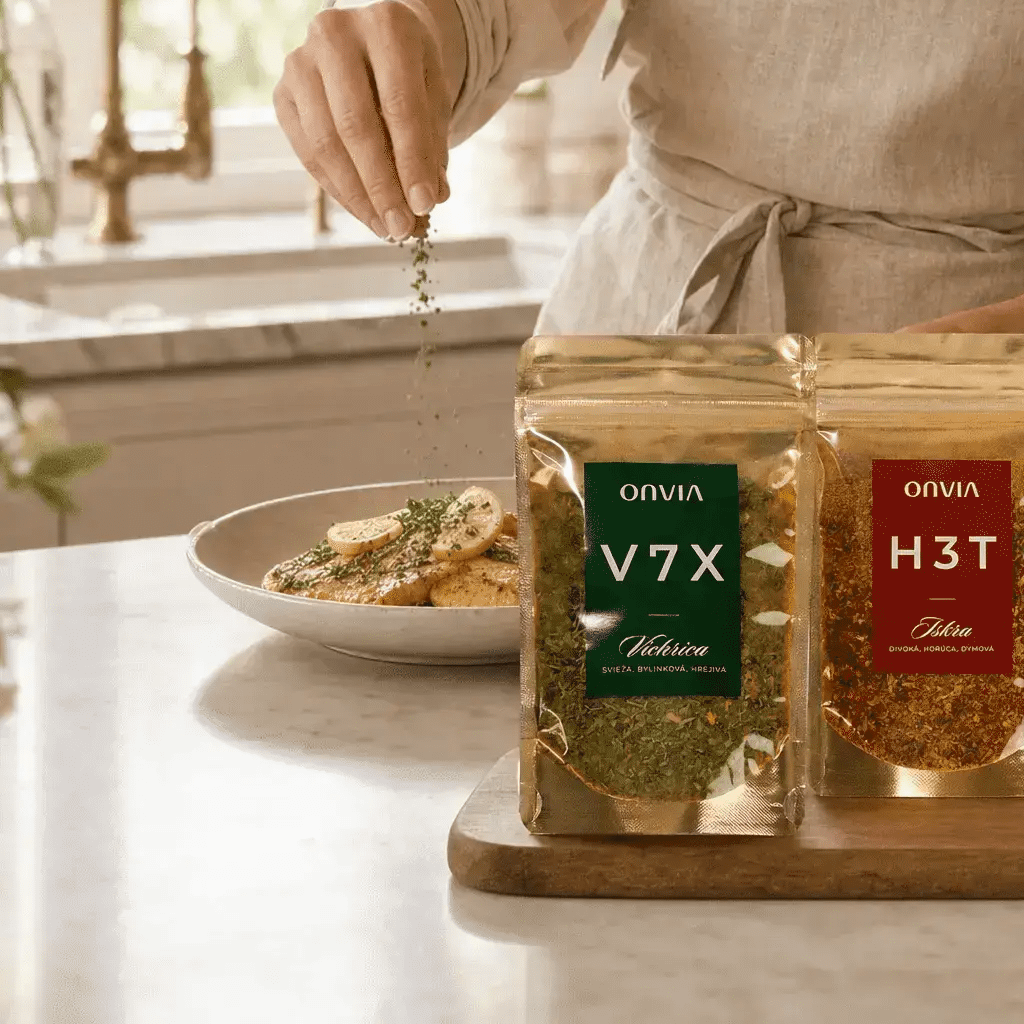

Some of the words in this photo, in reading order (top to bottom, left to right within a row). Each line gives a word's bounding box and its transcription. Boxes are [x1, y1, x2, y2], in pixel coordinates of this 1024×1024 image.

[619, 483, 704, 502] ONVIA
[903, 480, 980, 498] ONVIA
[600, 543, 725, 582] V7X
[890, 535, 998, 570] H3T
[910, 616, 973, 640] Iskra
